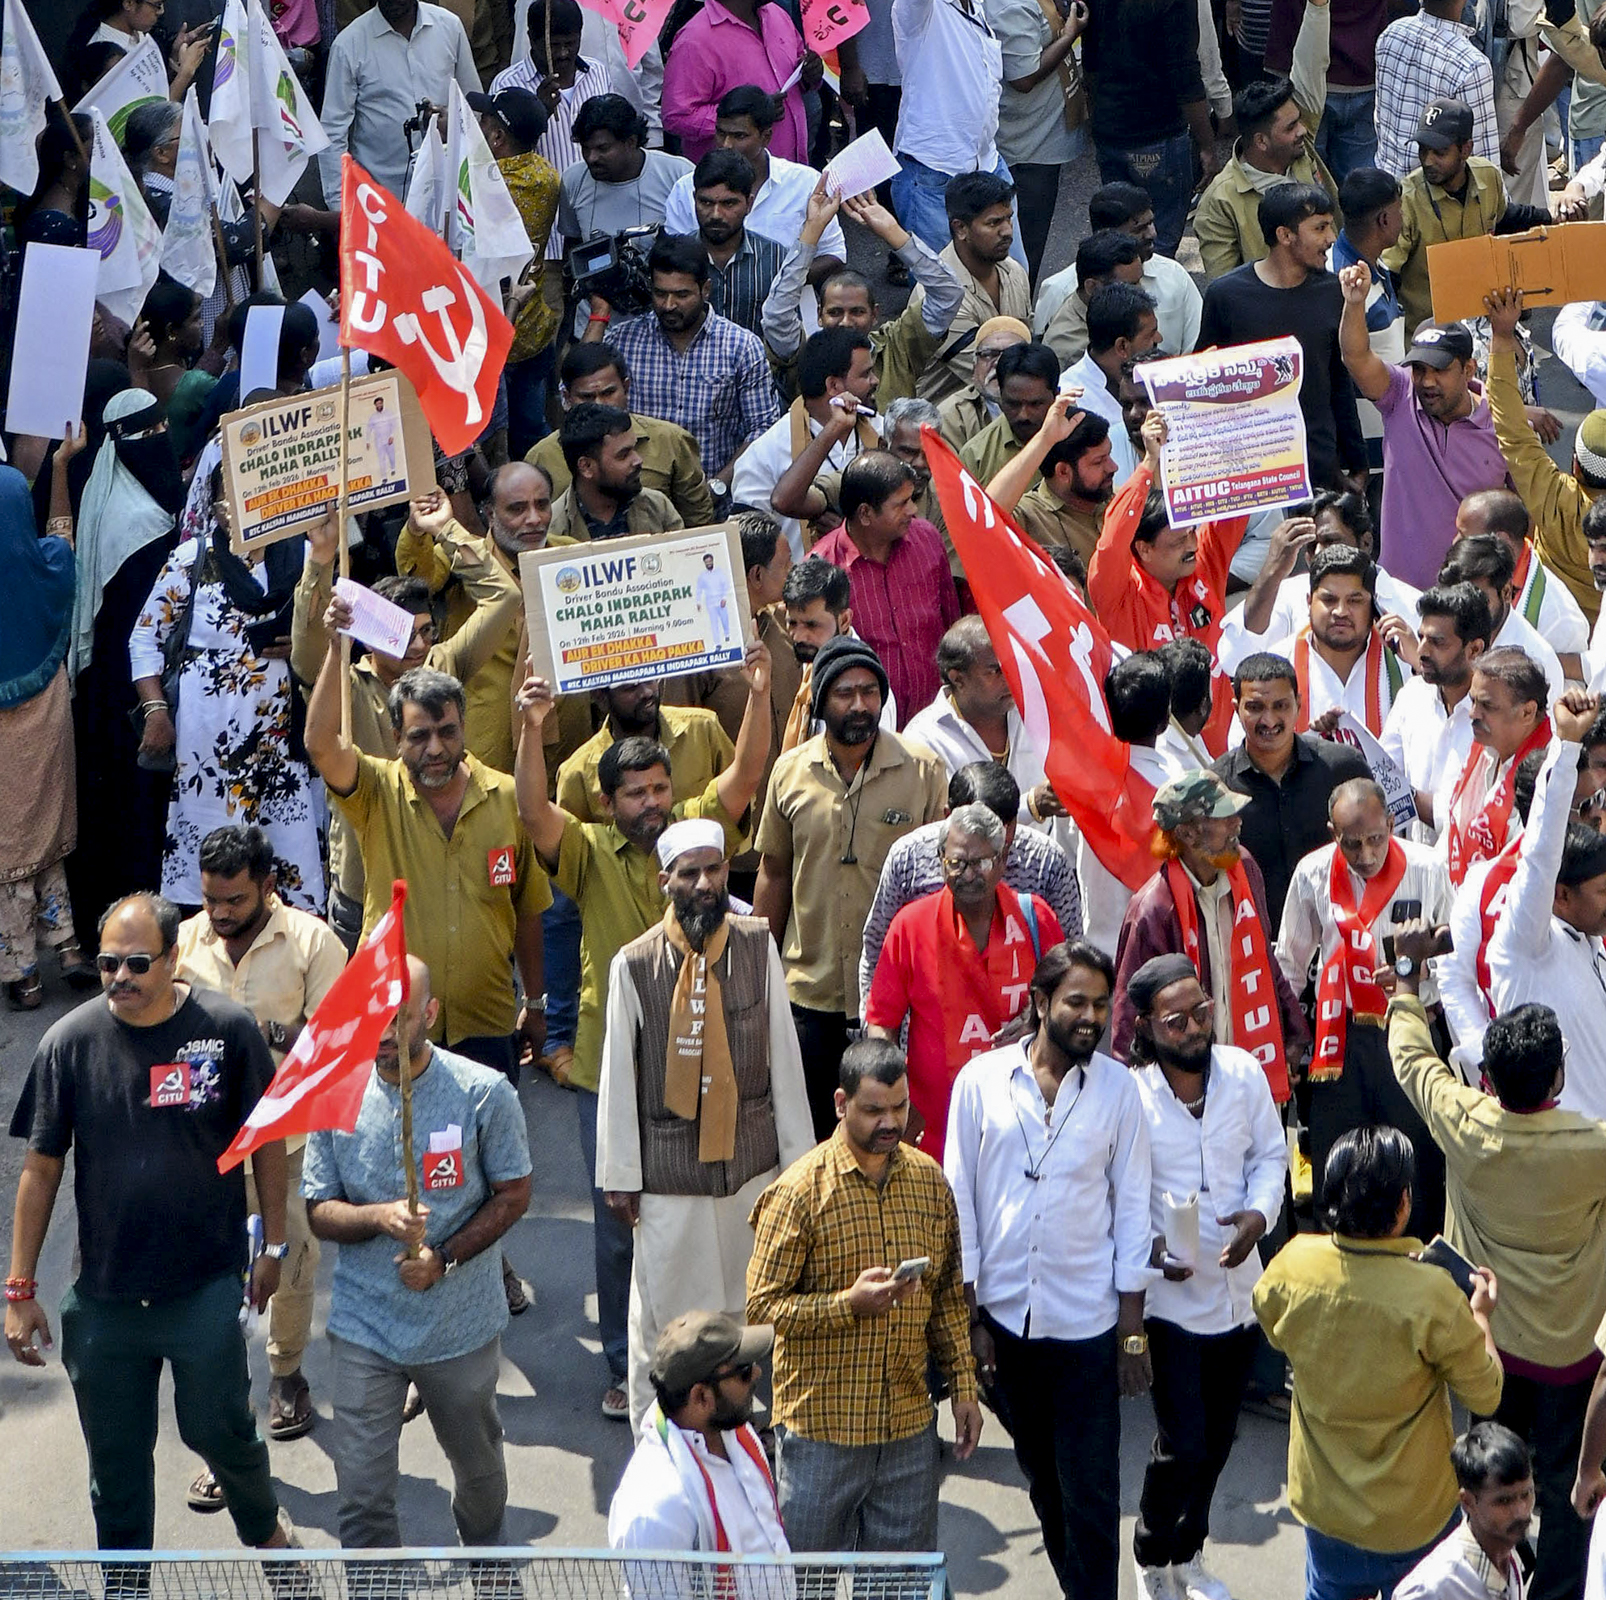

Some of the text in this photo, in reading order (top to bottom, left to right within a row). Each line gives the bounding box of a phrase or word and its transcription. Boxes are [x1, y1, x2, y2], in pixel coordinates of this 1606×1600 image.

[349, 183, 388, 333] CITU
[263, 407, 312, 439] ILWF
[247, 435, 298, 457] Driver Bandu
[240, 454, 279, 473] CHALO
[260, 461, 299, 480] MAHA
[1173, 471, 1300, 504] AITUC Telangana State Council
[248, 498, 268, 510] AUR
[261, 500, 296, 519] DRIVER
[583, 557, 637, 587] ILWF
[556, 586, 692, 621] CHALO INDRAPARK
[565, 578, 673, 605] Driver Bandu Association
[581, 605, 672, 632] MAHA RALLY
[560, 618, 694, 649] On 12th Feb 2026 Morning 9.00am
[566, 636, 653, 662] AUR EK DHAKKA
[583, 641, 704, 674] DRIVER KA HAQ PAKKA
[666, 657, 708, 672] INDRAPARK
[709, 652, 730, 664] RALLY
[494, 874, 512, 884] CITU
[158, 1092, 184, 1104] CITU
[431, 1176, 456, 1188] CITU
